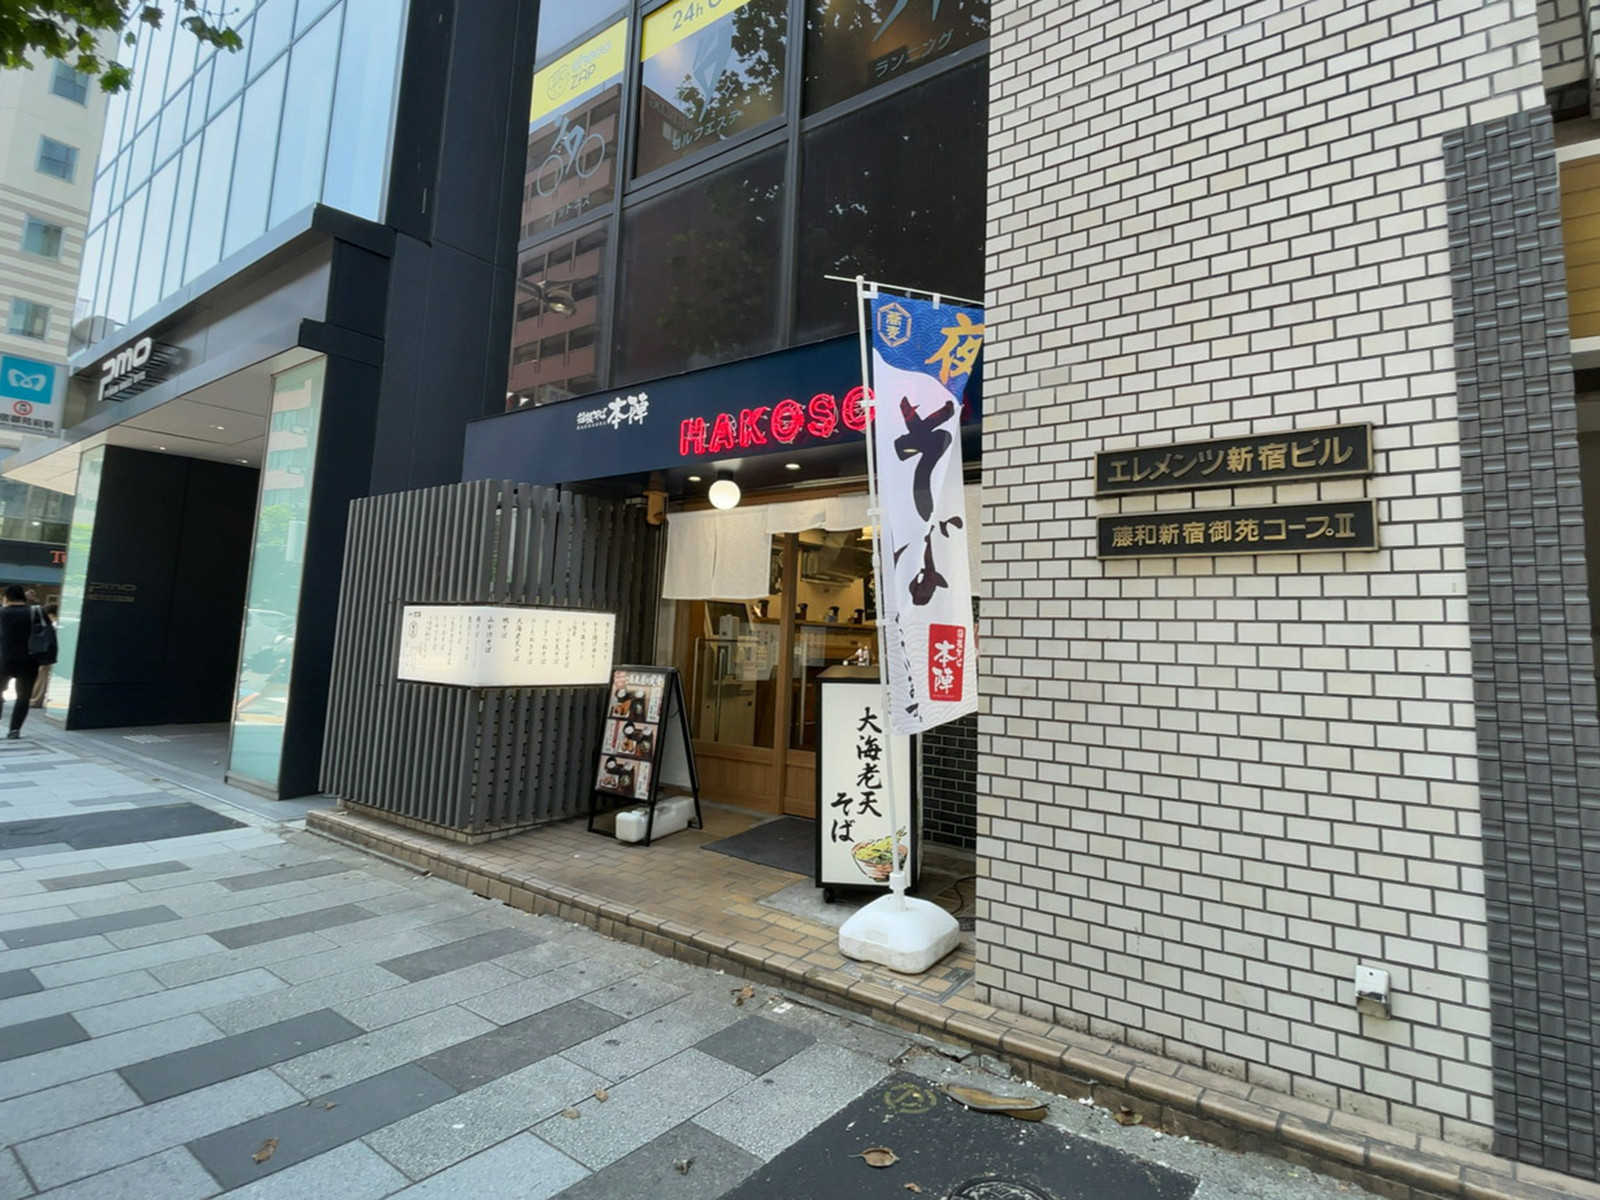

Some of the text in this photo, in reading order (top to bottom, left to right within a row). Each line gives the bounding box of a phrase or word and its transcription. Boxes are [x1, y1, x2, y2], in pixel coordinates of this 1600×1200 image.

[876, 28, 955, 78] ランニング
[671, 108, 744, 151] セルフエステ
[1107, 436, 1353, 484] エレメンツ新宿ビル
[856, 706, 883, 818] 大海老天
[830, 791, 856, 844] そば
